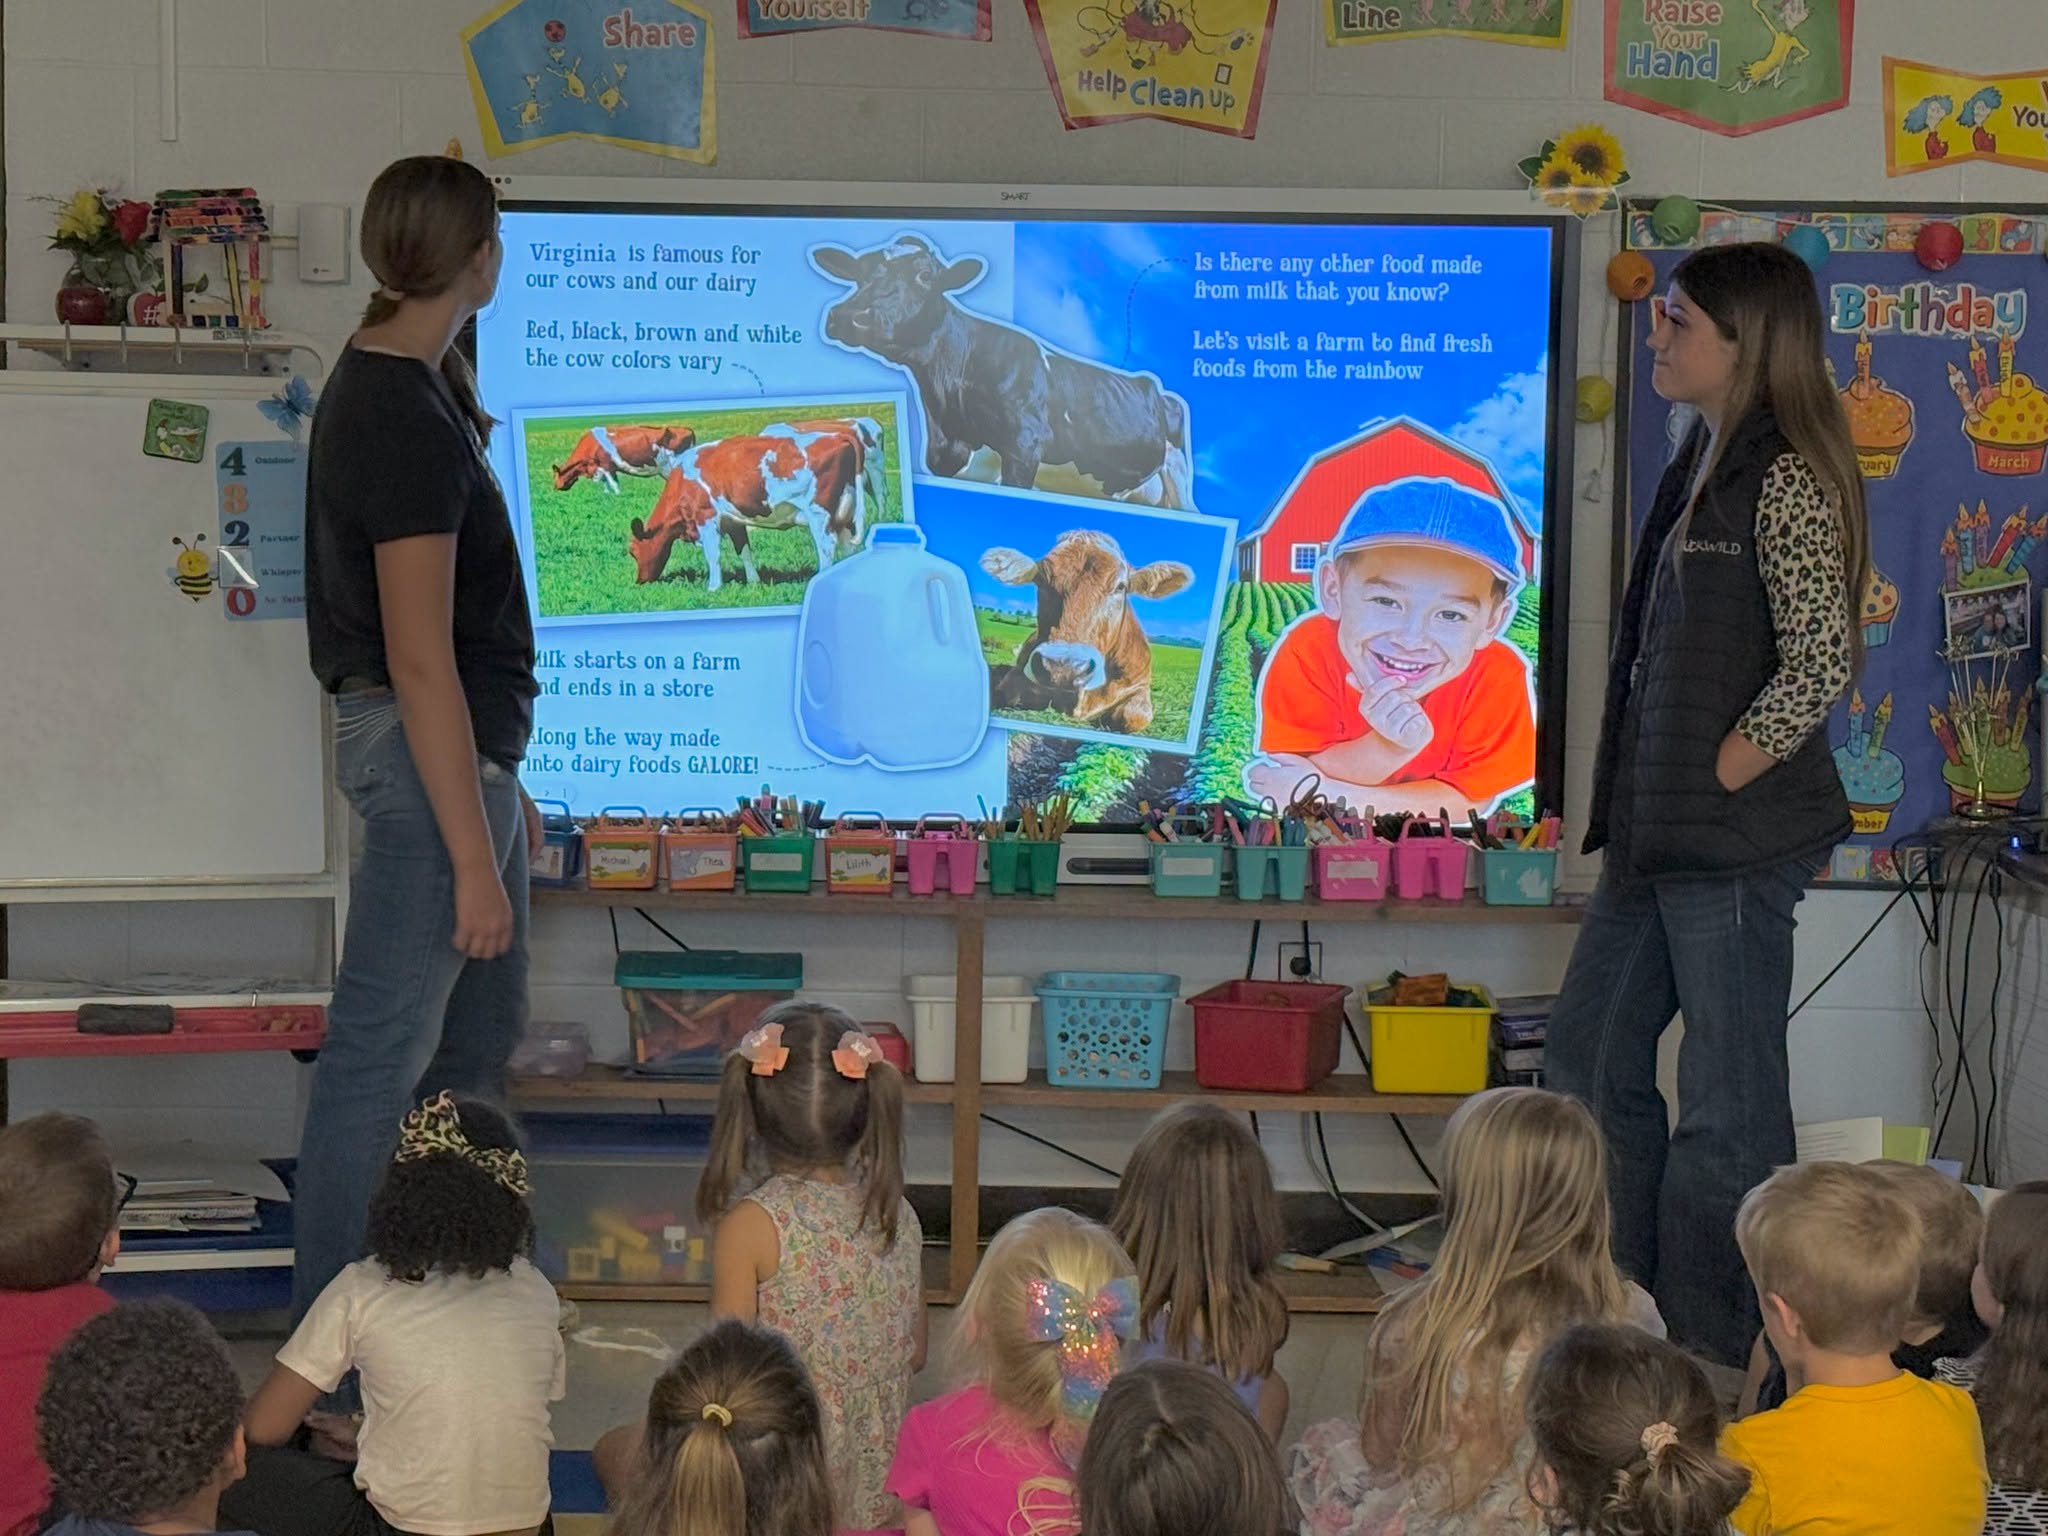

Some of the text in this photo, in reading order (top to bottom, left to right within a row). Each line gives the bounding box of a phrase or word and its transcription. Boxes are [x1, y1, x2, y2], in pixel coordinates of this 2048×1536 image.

[1342, 2, 1400, 31] Line
[1644, 0, 1722, 24] Raise
[603, 10, 696, 48] Share
[1653, 26, 1707, 50] Your
[1628, 44, 1718, 79] Hand
[1077, 68, 1127, 100] Help
[1130, 77, 1204, 109] Clean
[1001, 191, 1032, 201] SMART
[529, 242, 761, 267] Virginia is famous for
[1194, 252, 1483, 277] Is there any other food made
[526, 272, 756, 297] our cows and our dairy
[1194, 280, 1449, 305] from milk that you know?
[1834, 284, 2025, 338] Birthday
[526, 320, 802, 343] Red, black, brown and white
[1192, 330, 1493, 352] Let's visit a farm to find fresh
[525, 348, 722, 375] the cow colors vary
[1192, 358, 1424, 380] foods from the rainbow
[220, 447, 247, 476] 4
[1987, 454, 2031, 469] March
[224, 520, 250, 547] 2
[227, 588, 256, 616] 0
[574, 651, 637, 670] starts
[644, 655, 666, 670] on
[673, 656, 685, 670] a
[692, 652, 740, 670] farm
[539, 677, 714, 697] nd ends in a store
[584, 727, 616, 746] the
[624, 731, 662, 750] way
[670, 729, 720, 747] made
[526, 754, 759, 778] into dairy foods GALORE!
